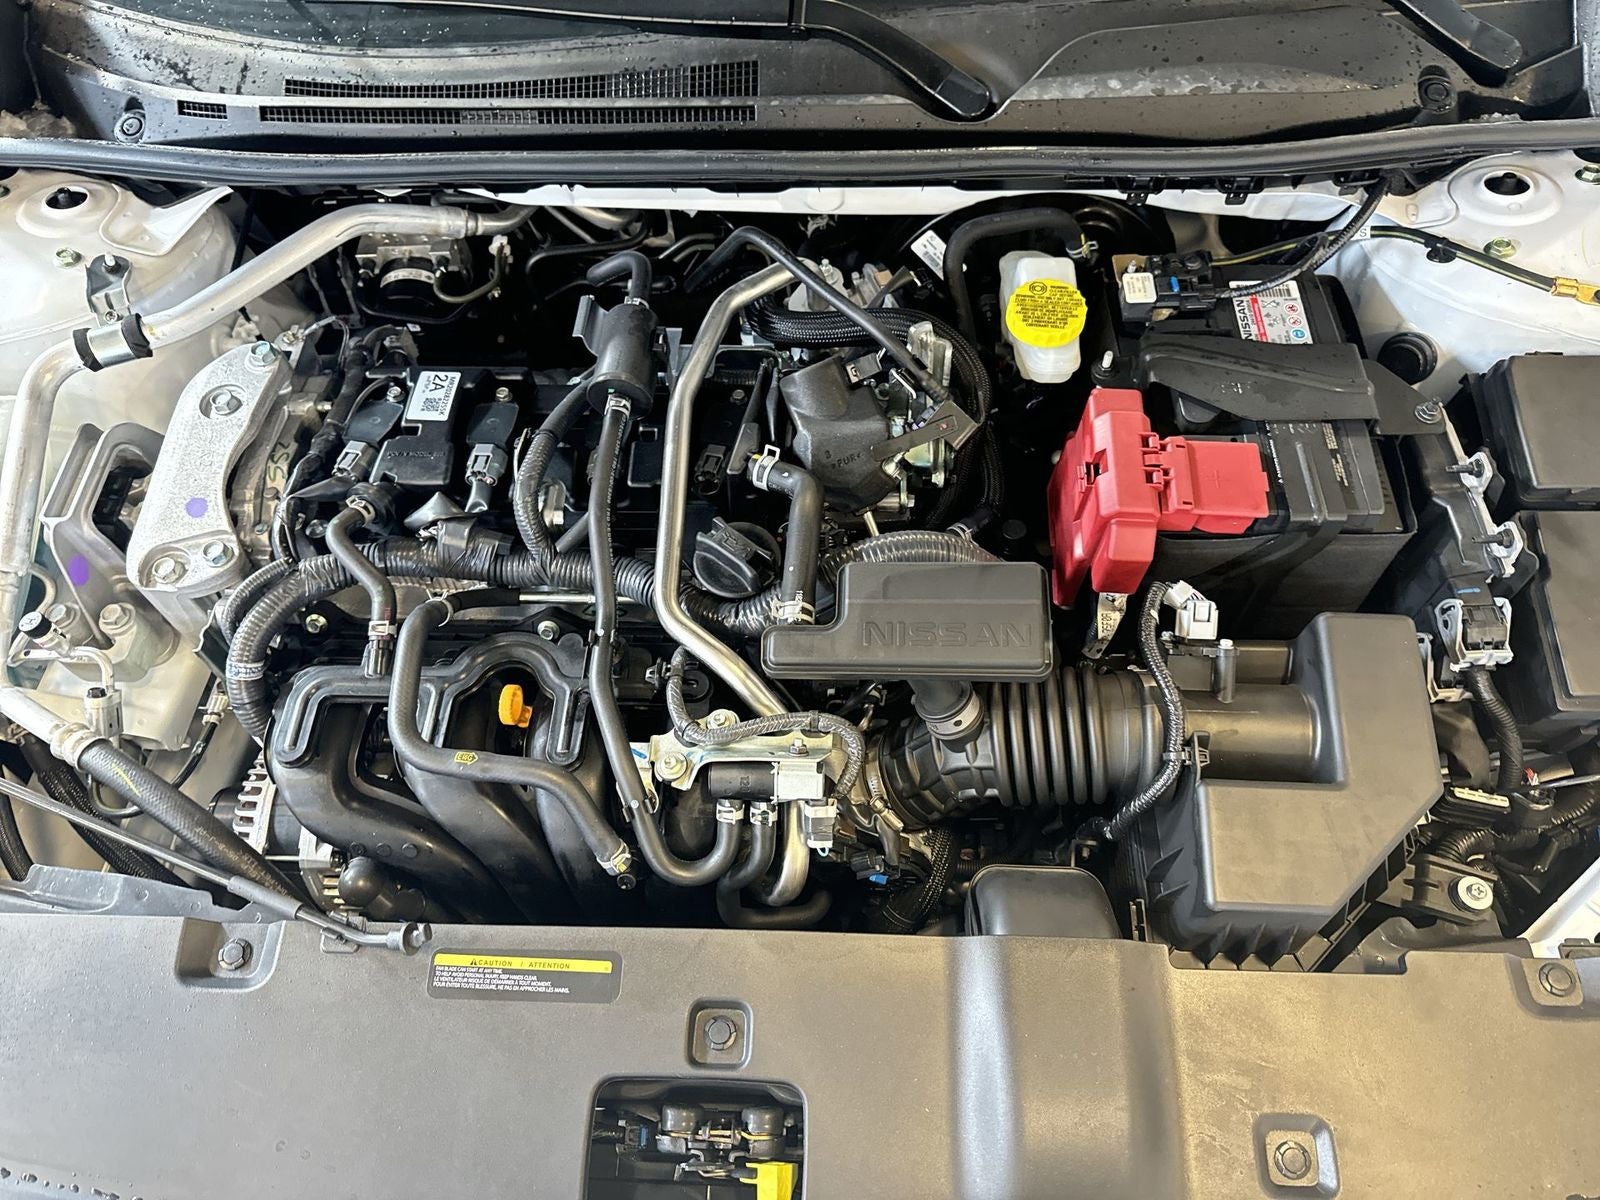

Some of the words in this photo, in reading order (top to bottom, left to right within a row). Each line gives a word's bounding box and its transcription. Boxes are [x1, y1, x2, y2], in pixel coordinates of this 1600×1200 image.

[1235, 299, 1253, 340] NISSAN
[429, 374, 449, 392] 2A
[863, 621, 1032, 647] NISSAN
[478, 959, 513, 967] CAUTION
[529, 961, 570, 969] ATTENTION
